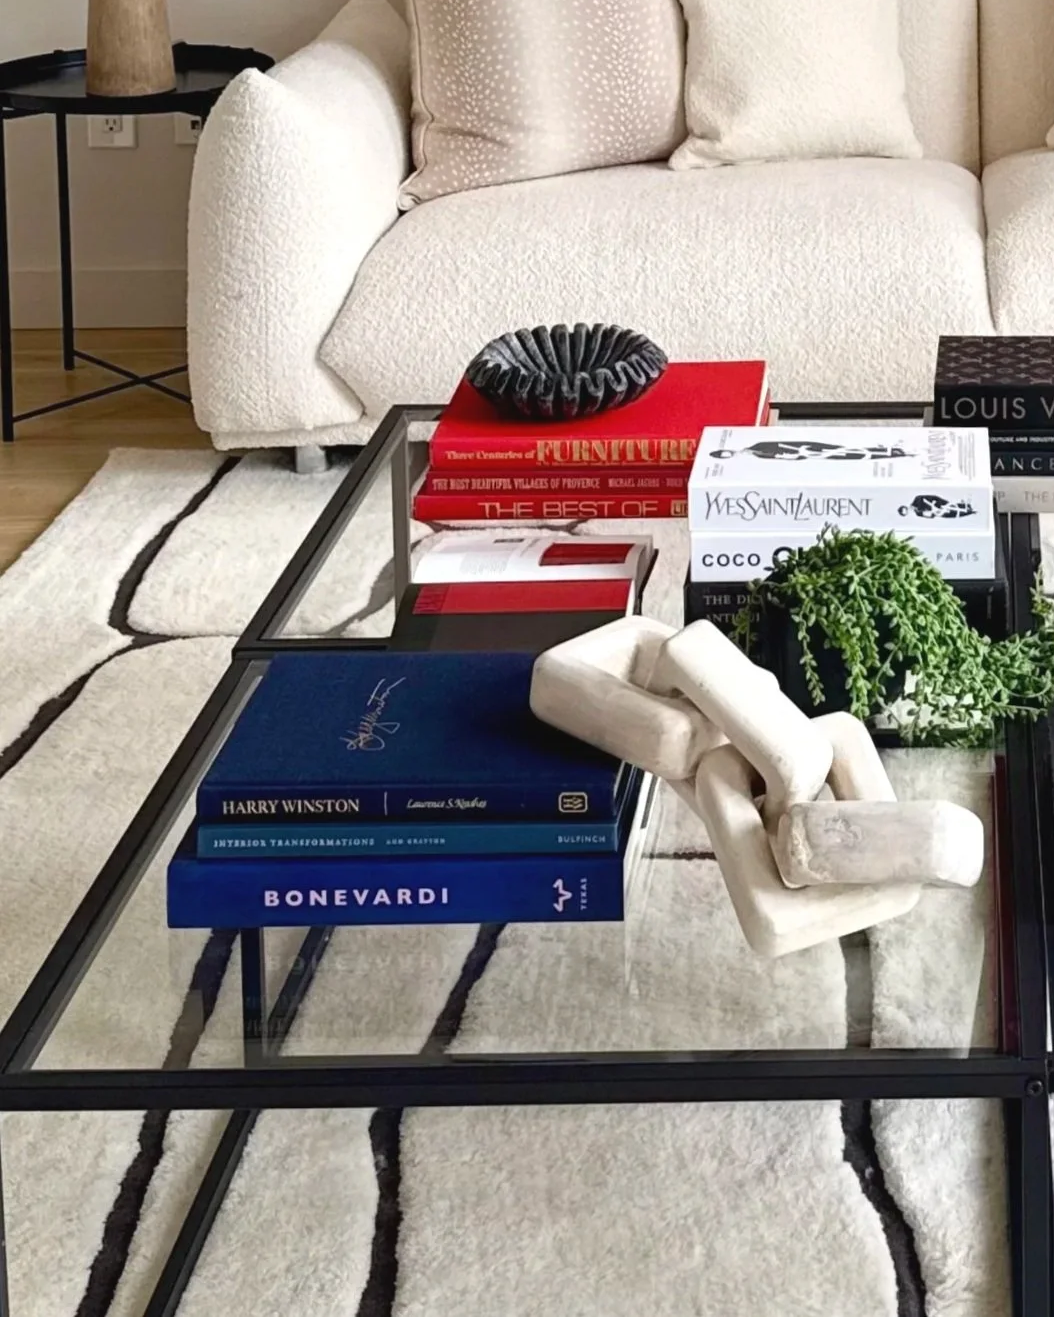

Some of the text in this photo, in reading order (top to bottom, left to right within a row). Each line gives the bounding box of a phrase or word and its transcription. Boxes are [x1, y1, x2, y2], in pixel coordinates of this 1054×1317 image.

[941, 397, 1027, 420] LOUIS
[536, 439, 697, 462] FURNITURE
[550, 478, 560, 490] OF
[1024, 491, 1049, 503] THE
[478, 502, 535, 519] THE
[543, 501, 615, 518] BEST
[621, 501, 659, 518] OF
[702, 553, 761, 567] COCO
[936, 552, 980, 562] PARIS
[703, 594, 732, 606] THE
[222, 798, 361, 815] HARRY WINSTON
[213, 838, 375, 849] INTERIOR TRANSFORMATIONS
[557, 835, 607, 843] BULFINCH
[263, 887, 449, 908] BONEVARDI
[580, 877, 588, 911] TEXAS
